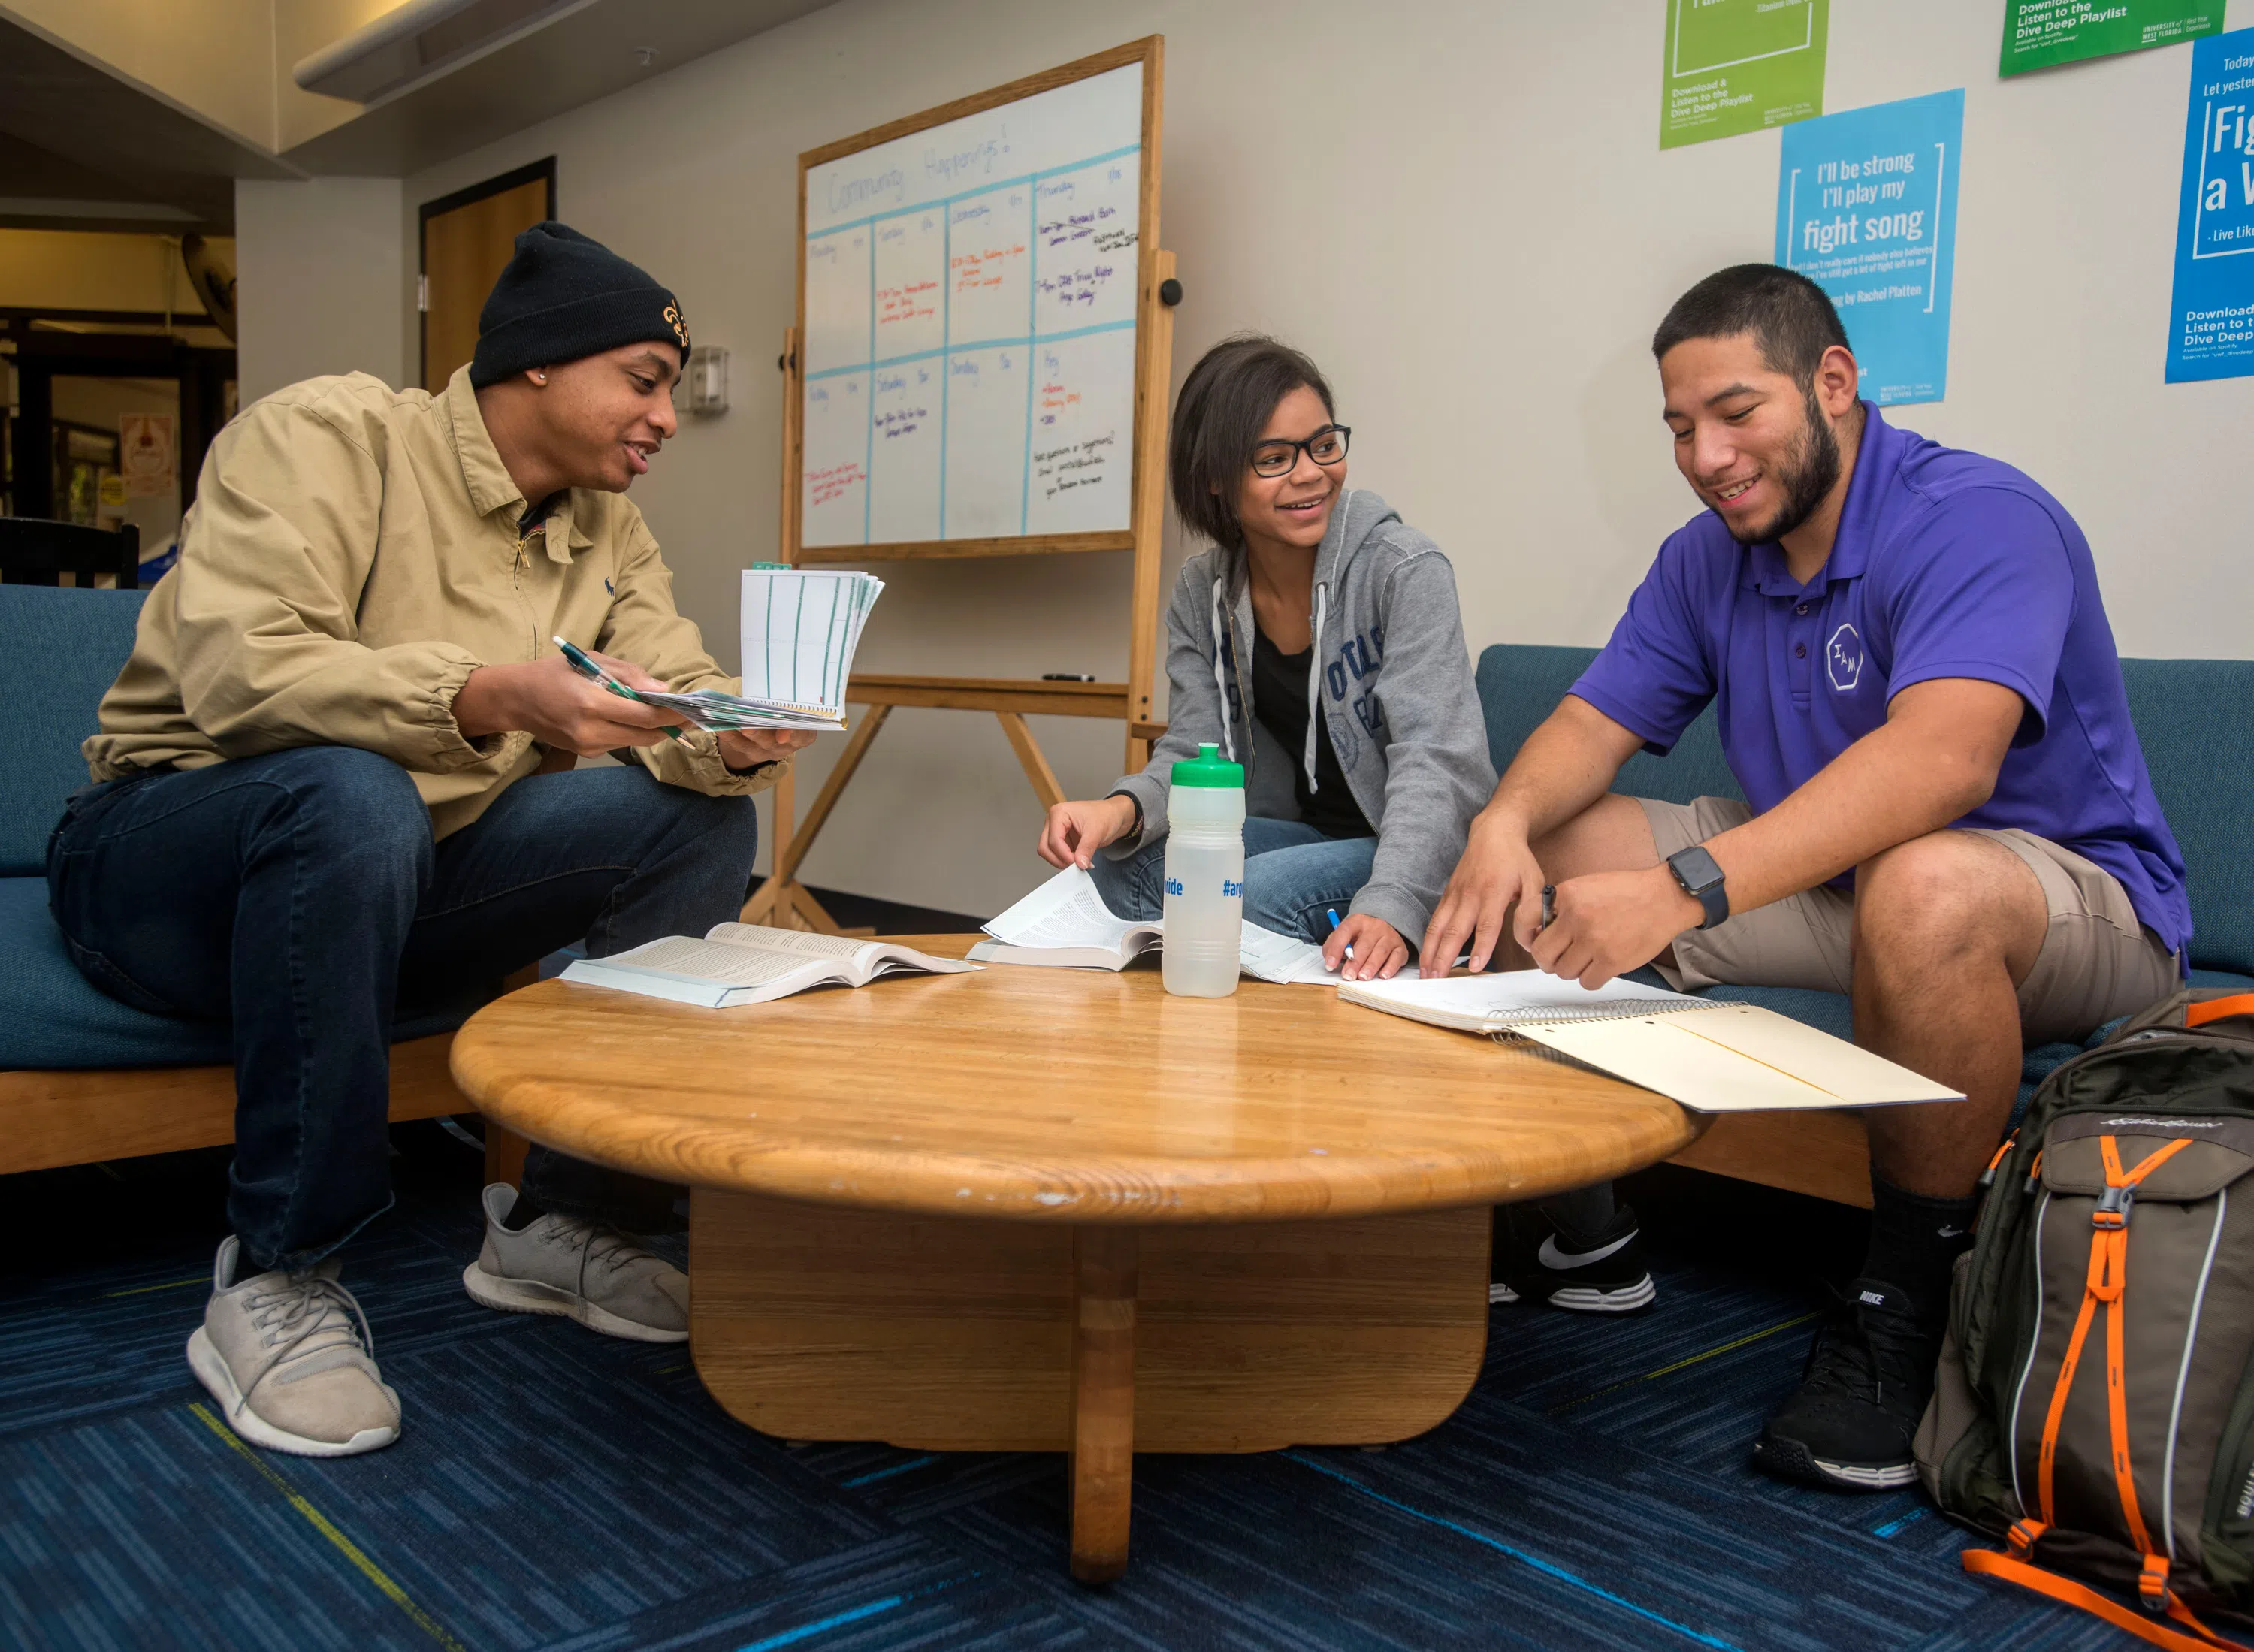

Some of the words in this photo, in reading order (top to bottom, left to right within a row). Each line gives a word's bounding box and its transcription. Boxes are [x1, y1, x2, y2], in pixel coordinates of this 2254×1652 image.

[2017, 26, 2042, 38] Dive
[2045, 18, 2076, 32] Deep
[2080, 6, 2127, 24] Playlist
[2018, 11, 2052, 27] Listen
[2056, 8, 2068, 17] to
[2071, 3, 2092, 14] the
[2143, 21, 2175, 33] UNIVERSITY
[2159, 27, 2182, 37] FLORIDA
[2186, 23, 2211, 32] Experience
[1672, 80, 1718, 98] Download
[1720, 78, 1727, 87] &
[2204, 83, 2220, 97] Let
[1671, 107, 1691, 118] Dive
[1694, 102, 1718, 113] Deep
[1719, 93, 1754, 107] Playlist
[1672, 96, 1699, 108] Listen
[1713, 89, 1728, 99] the
[1817, 161, 1837, 184] I'll
[1840, 160, 1860, 180] be
[1863, 153, 1915, 177] strong
[1823, 186, 1842, 209] I'll
[1845, 183, 1878, 209] play
[1881, 180, 1906, 200] my
[2205, 177, 2227, 211] a
[1803, 214, 1859, 254] fight
[1864, 210, 1925, 241] song
[2213, 228, 2233, 242] Live
[1865, 251, 1888, 262] nobody
[1845, 291, 1856, 306] by
[1857, 287, 1887, 303] Rachel
[1889, 284, 1922, 299] Platten
[2187, 304, 2254, 322] Download
[2186, 322, 2225, 334] Listen
[2230, 319, 2243, 328] to
[2185, 334, 2213, 346] Dive
[2218, 331, 2254, 342] Deep
[1859, 1290, 1885, 1305] NIKE
